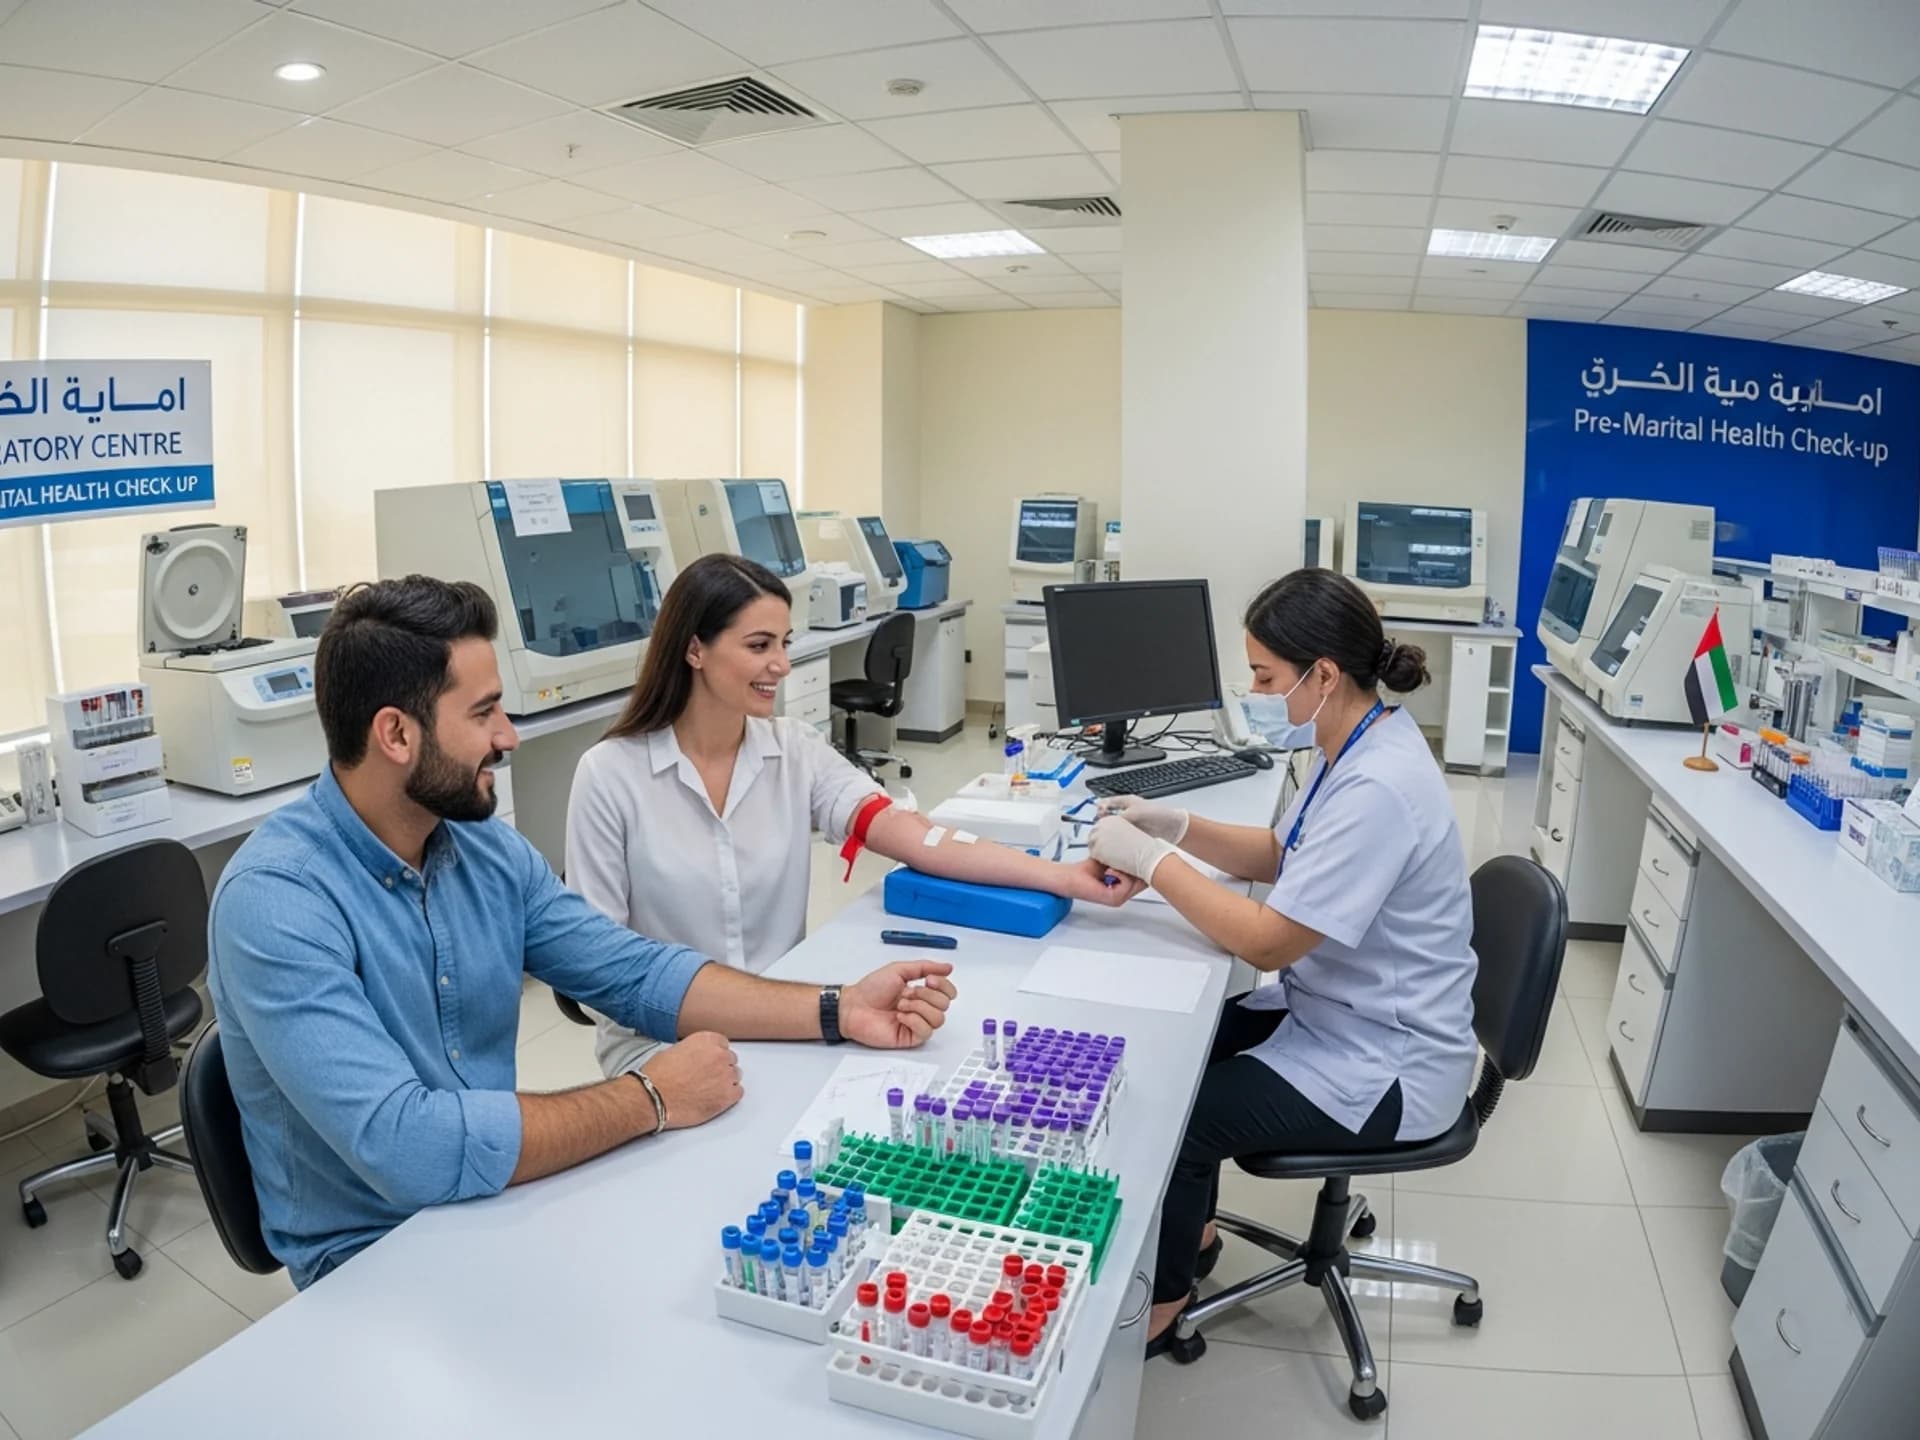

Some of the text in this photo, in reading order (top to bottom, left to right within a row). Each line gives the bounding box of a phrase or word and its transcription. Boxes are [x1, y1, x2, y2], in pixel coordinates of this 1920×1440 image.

[0, 432, 182, 465] ATORY CENTRE
[1711, 418, 1784, 449] Health
[1791, 428, 1889, 467] Check-up
[41, 481, 109, 505] HEALTH
[114, 477, 171, 497] CHECK
[176, 476, 198, 492] UP
